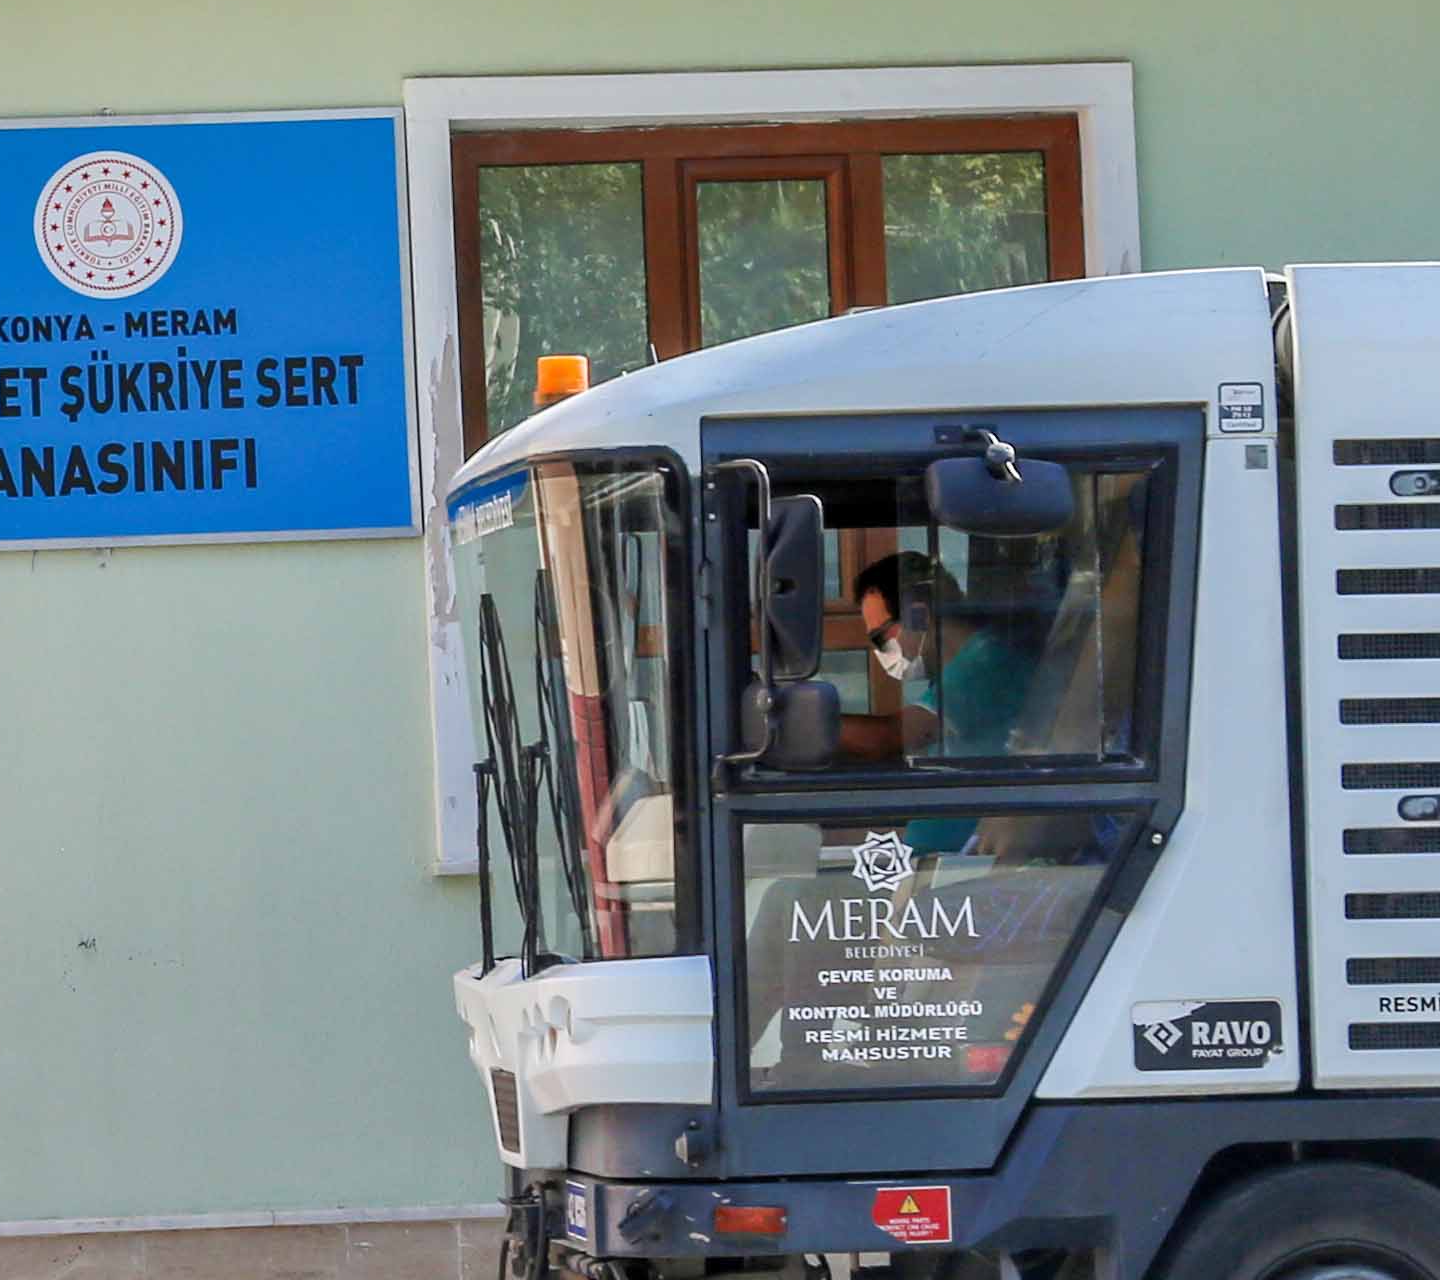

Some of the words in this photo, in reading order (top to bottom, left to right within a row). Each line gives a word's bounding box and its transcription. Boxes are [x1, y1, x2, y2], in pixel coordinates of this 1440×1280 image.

[124, 308, 237, 337] MERAM
[59, 346, 244, 423] ŞÜKRİYE
[255, 354, 364, 408] SERT
[788, 896, 982, 942] MERAM
[818, 969, 875, 986] ÇEVRE
[879, 968, 953, 982] KORUMA
[873, 987, 897, 1000] VE
[789, 1006, 870, 1021] KONTROL
[875, 1000, 982, 1018] MÜDÜRLÜĞÜ
[805, 1026, 870, 1043] RESMİ
[877, 1025, 968, 1042] HİZMETE
[1191, 1021, 1271, 1046] RAVO
[821, 1046, 952, 1061] MAHSUSTUR
[1192, 1048, 1224, 1058] FAYAT
[1226, 1047, 1264, 1058] GROUP
